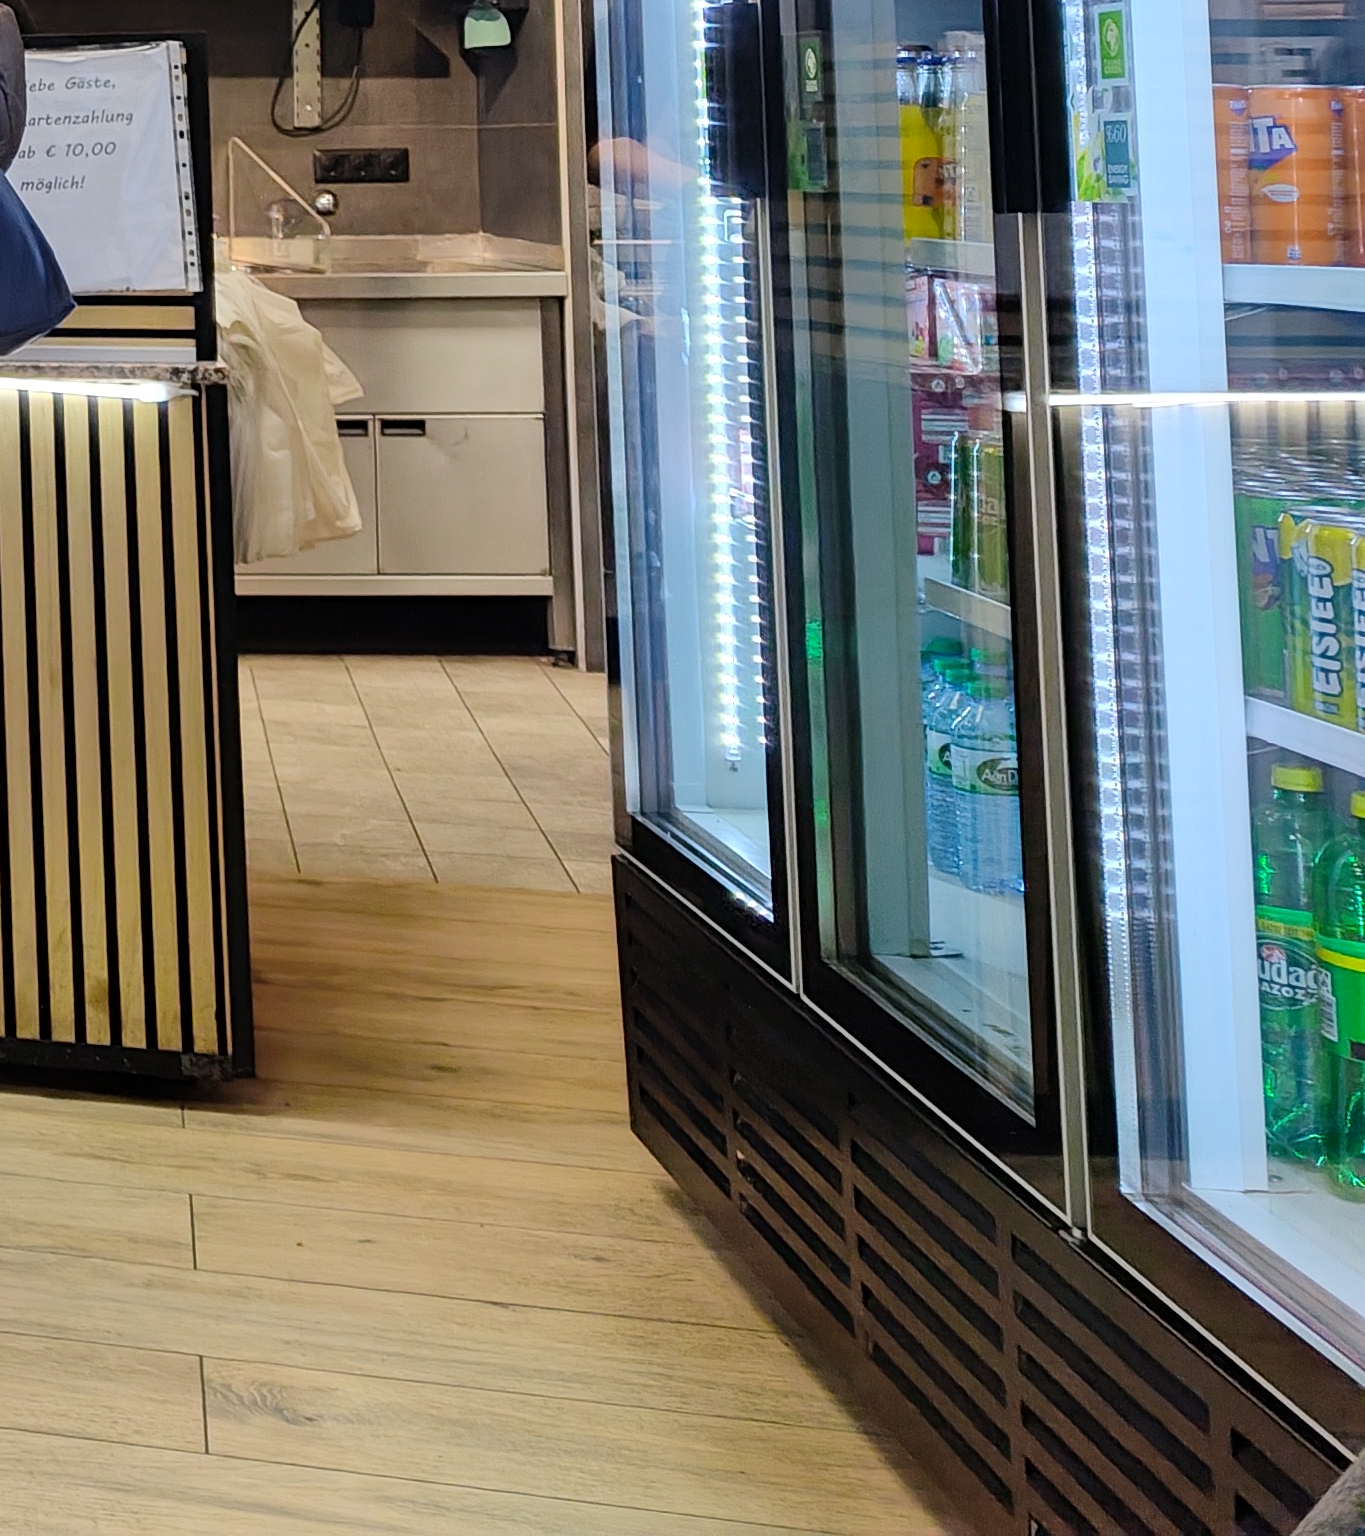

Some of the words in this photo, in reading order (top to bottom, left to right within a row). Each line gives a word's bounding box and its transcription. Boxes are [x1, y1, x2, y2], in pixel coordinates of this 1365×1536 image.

[26, 79, 55, 92] ebe
[65, 77, 116, 90] Gäste,
[27, 110, 133, 126] artenzahlung
[18, 146, 36, 159] ab
[65, 142, 117, 158] 10,00
[20, 176, 86, 193] möglich!
